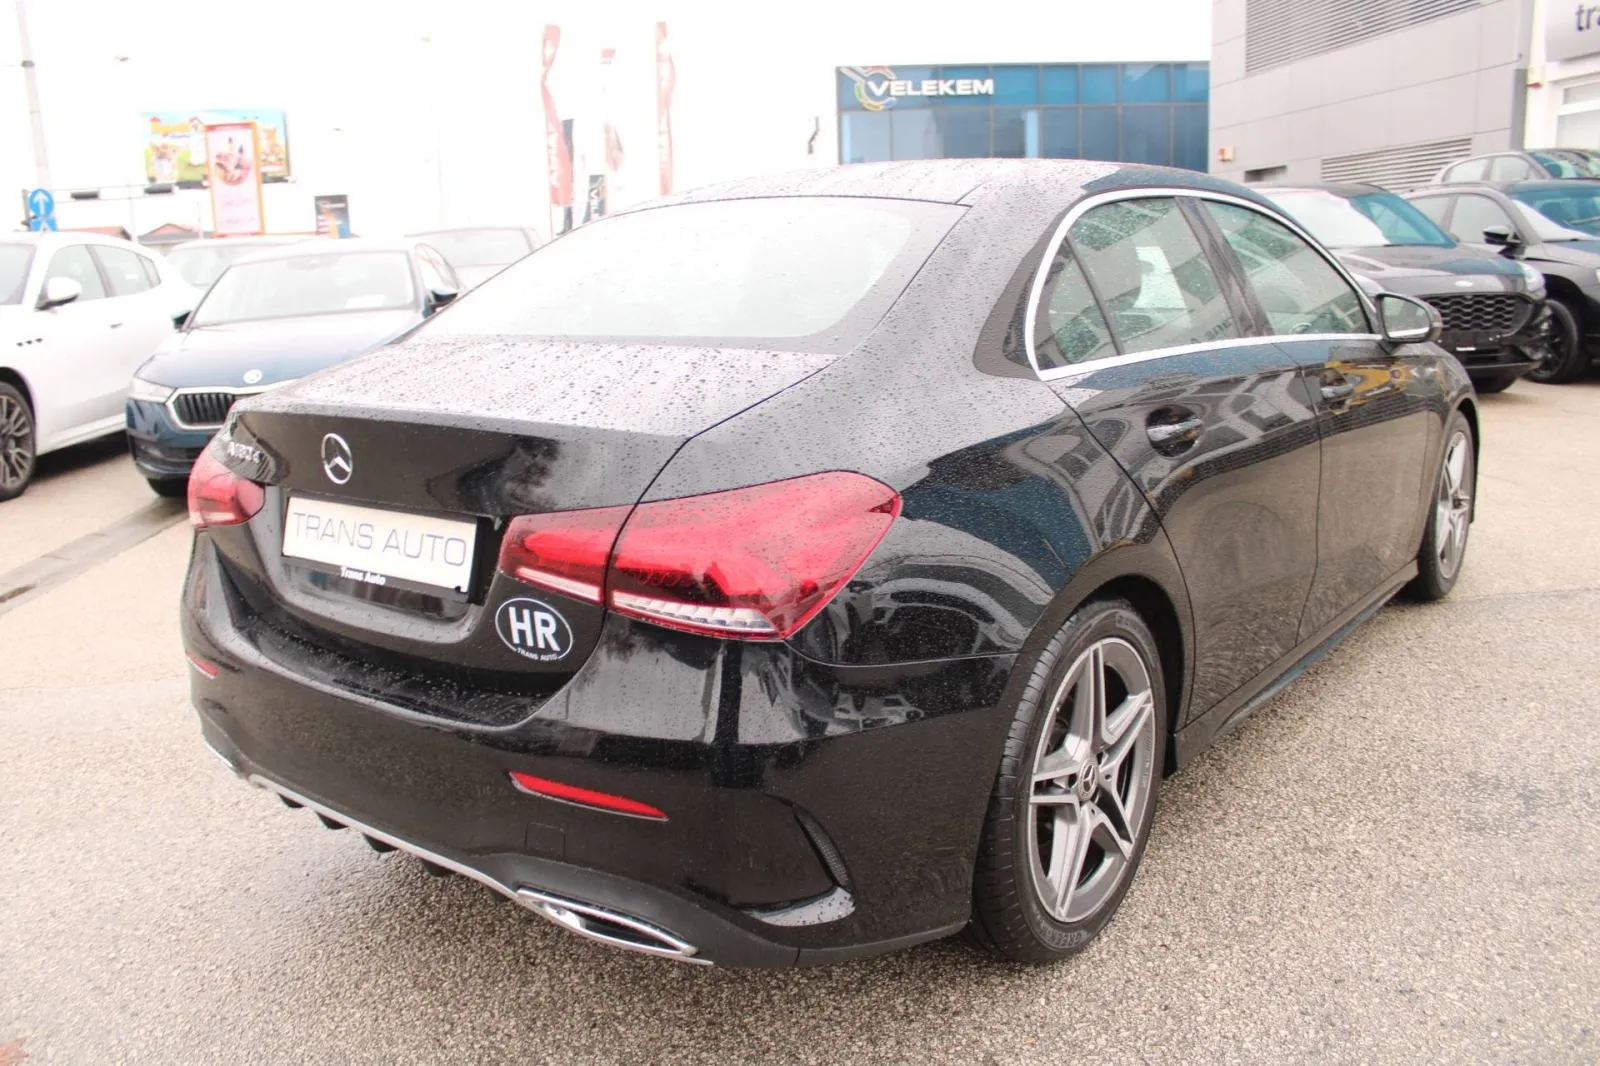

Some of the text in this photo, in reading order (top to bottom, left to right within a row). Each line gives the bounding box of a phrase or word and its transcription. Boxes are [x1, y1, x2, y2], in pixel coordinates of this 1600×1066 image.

[1575, 4, 1600, 31] tr
[867, 78, 995, 96] VELEKEM
[293, 511, 467, 567] TRANS AUTO
[340, 566, 386, 586] Trans Auto
[508, 606, 561, 651] HR
